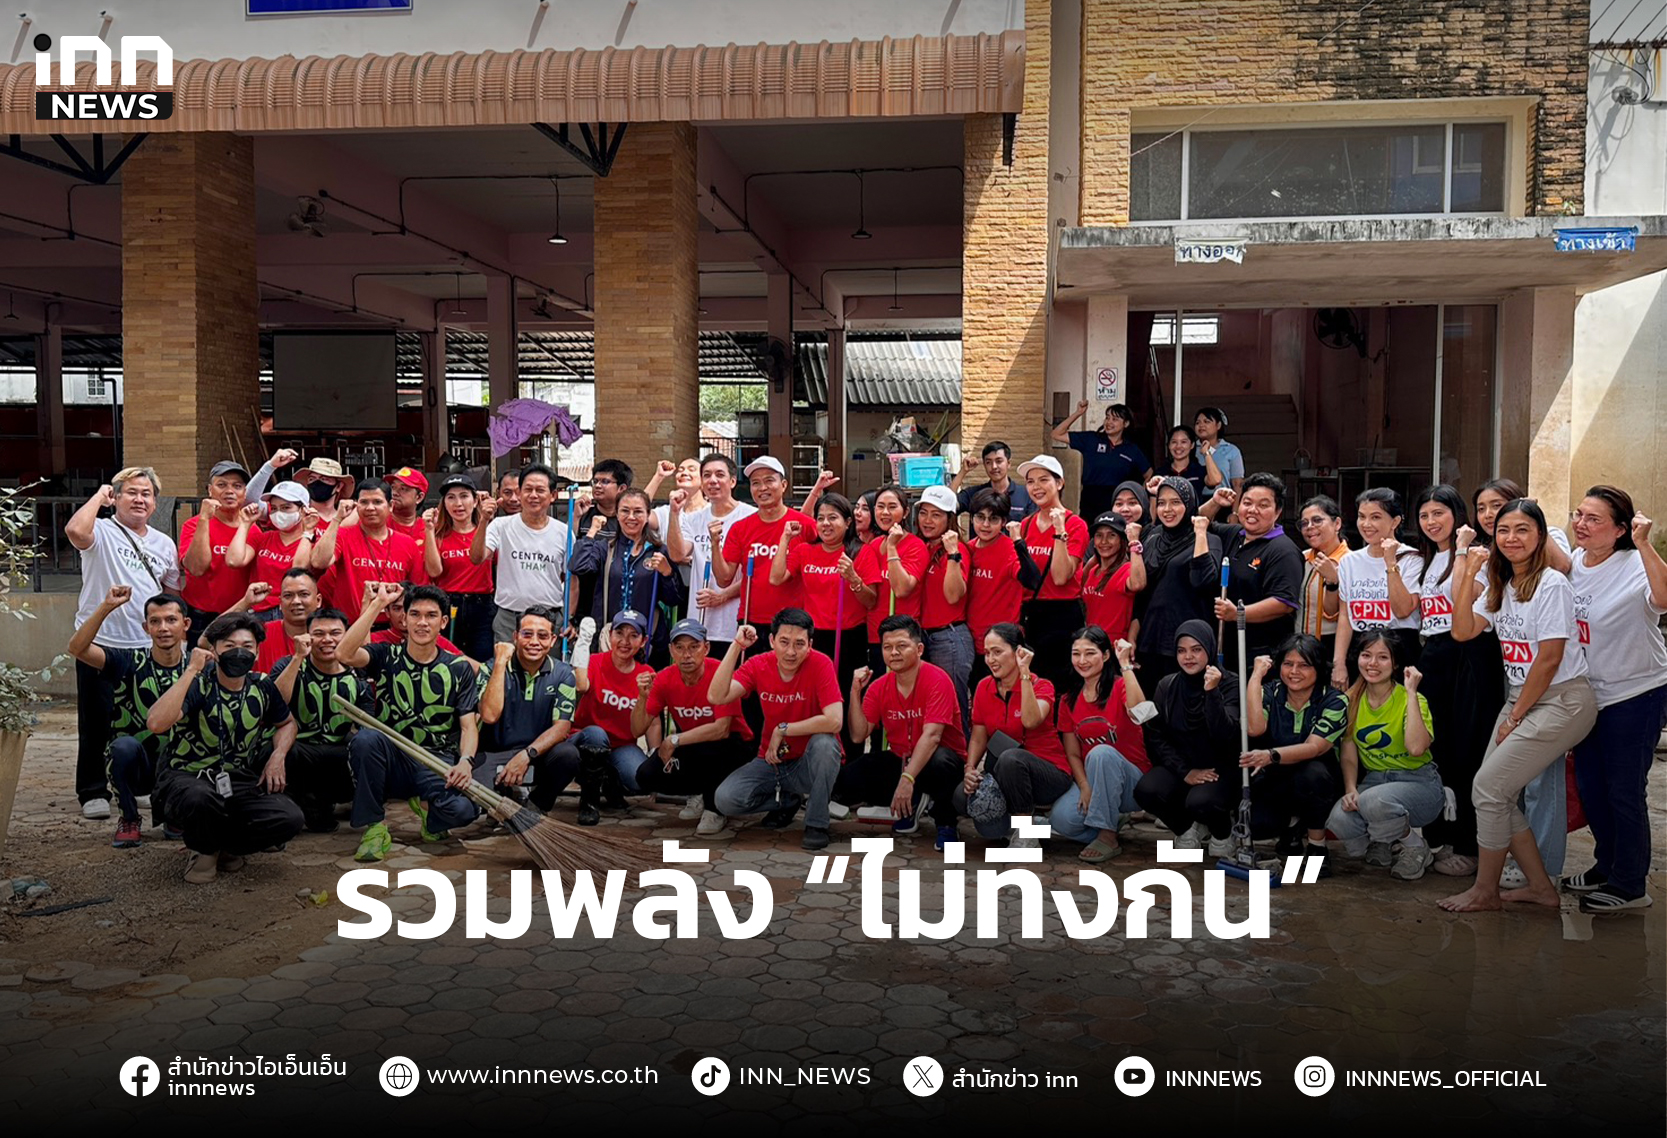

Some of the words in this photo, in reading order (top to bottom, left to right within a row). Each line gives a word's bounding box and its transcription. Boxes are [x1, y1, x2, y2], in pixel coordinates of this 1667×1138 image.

[1560, 232, 1626, 251] ทางเข้า
[258, 548, 296, 564] CENTR
[441, 547, 471, 560] CENT
[511, 550, 557, 565] CENTRAL
[751, 542, 780, 560] Top
[352, 556, 405, 572] CENTRAL
[520, 561, 547, 573] THAM
[803, 563, 840, 576] CENTR
[1352, 602, 1388, 619] CPN
[1503, 642, 1530, 662] PN
[602, 689, 638, 711] Tops
[674, 706, 714, 721] Tops
